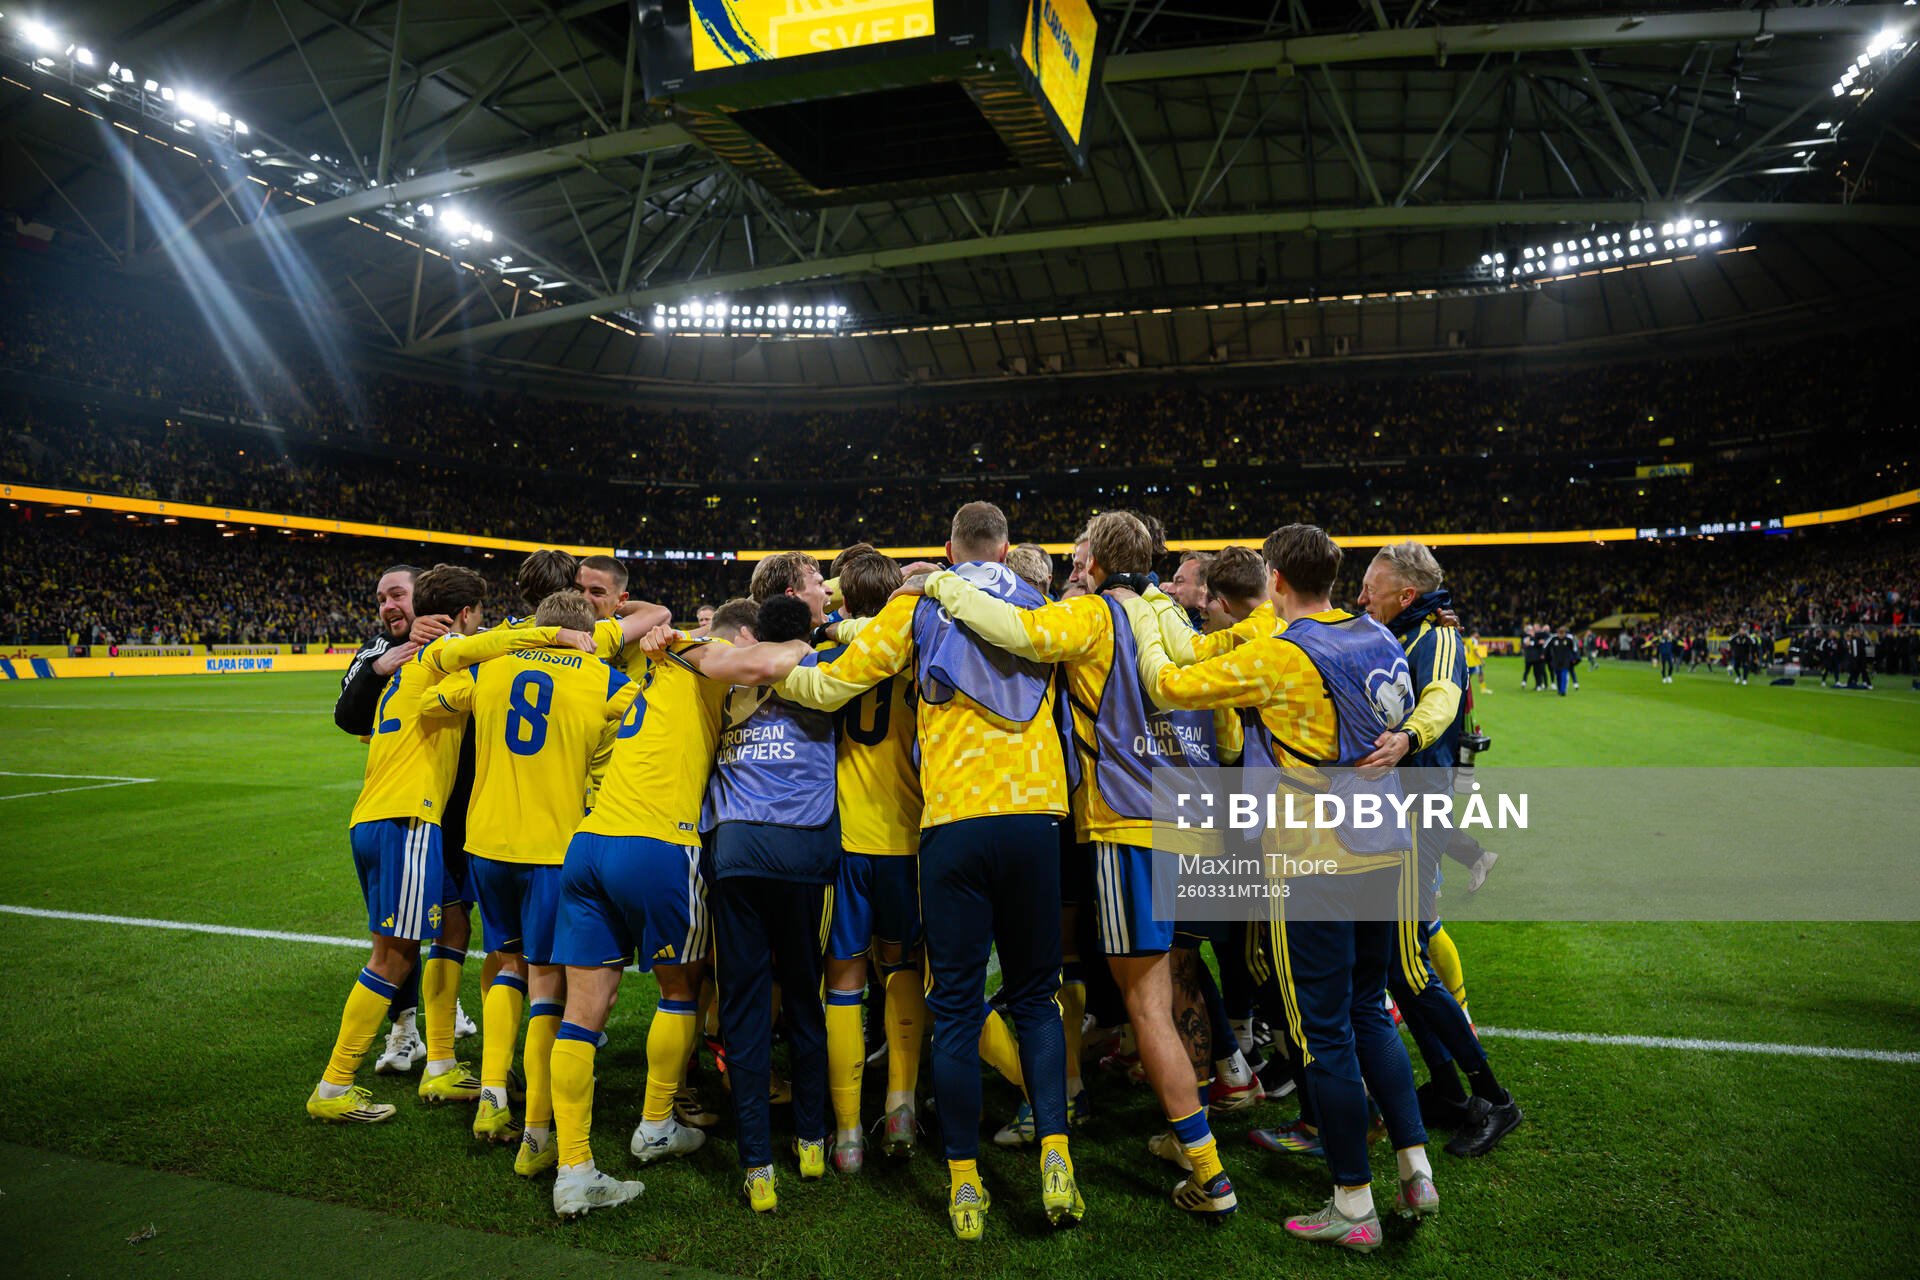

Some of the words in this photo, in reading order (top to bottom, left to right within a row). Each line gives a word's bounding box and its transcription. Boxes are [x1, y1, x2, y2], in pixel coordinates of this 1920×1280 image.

[1639, 528, 1658, 538] SWE
[1680, 526, 1686, 536] 3
[1700, 523, 1724, 534] 90:00
[1740, 521, 1746, 532] 2
[1769, 518, 1781, 528] POL
[647, 550, 653, 558] 3
[696, 551, 702, 560] 2
[722, 551, 736, 560] POL
[206, 658, 237, 671] KLARA
[505, 669, 554, 756] 8
[720, 725, 785, 747] UROPEAN
[717, 741, 796, 765] UALIFIERS
